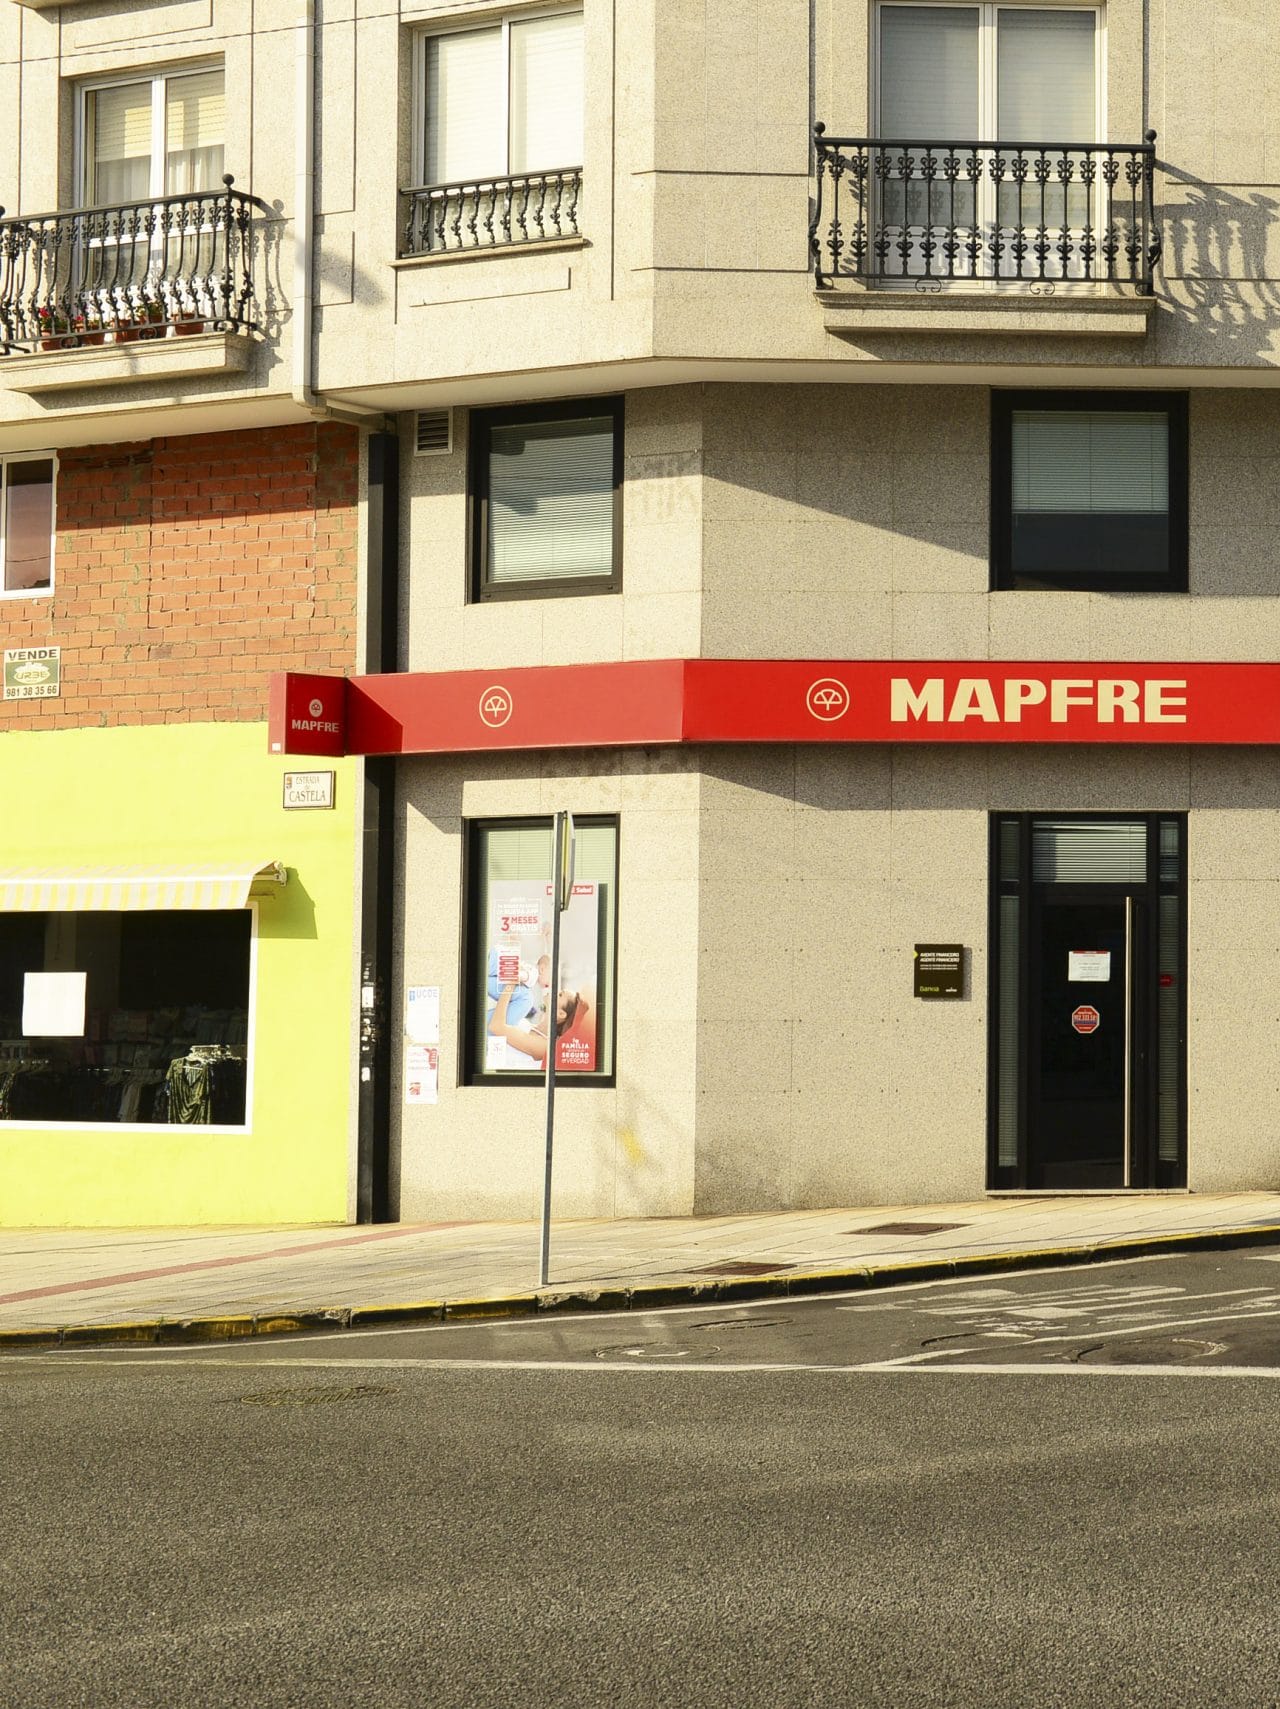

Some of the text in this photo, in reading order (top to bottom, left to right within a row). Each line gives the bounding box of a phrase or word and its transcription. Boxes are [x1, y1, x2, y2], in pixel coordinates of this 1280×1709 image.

[8, 649, 57, 660] VENDE
[6, 688, 20, 698] 981
[23, 686, 32, 696] 38
[35, 686, 44, 695] 35
[889, 678, 1187, 724] MAPFRE
[292, 719, 340, 733] MAPFRE
[296, 776, 320, 784] ESTRADA
[289, 790, 326, 802] CASTELA
[500, 916, 538, 932] 3 MESES
